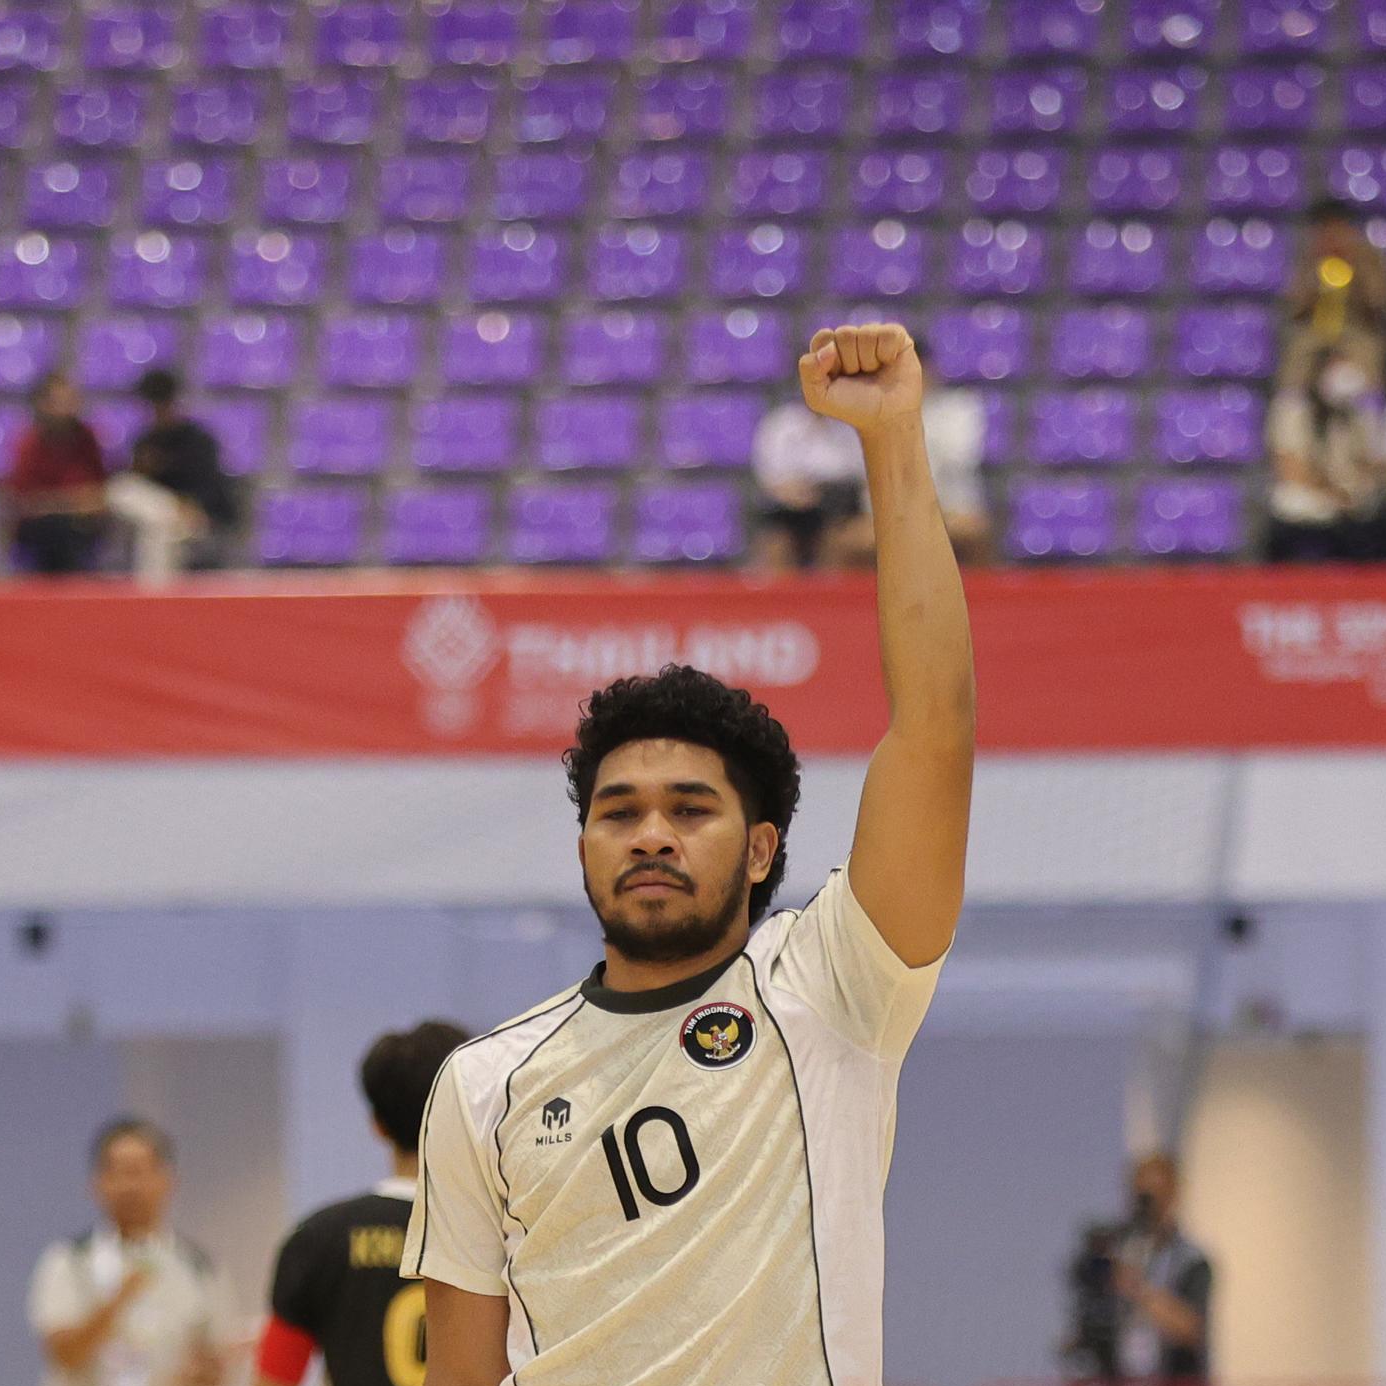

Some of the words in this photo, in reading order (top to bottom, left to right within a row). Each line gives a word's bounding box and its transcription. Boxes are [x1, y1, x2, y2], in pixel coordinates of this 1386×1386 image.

[684, 1018, 698, 1035] TIM
[695, 1006, 743, 1020] INDONESIA
[535, 1132, 572, 1147] MILLS
[601, 1105, 700, 1222] 10
